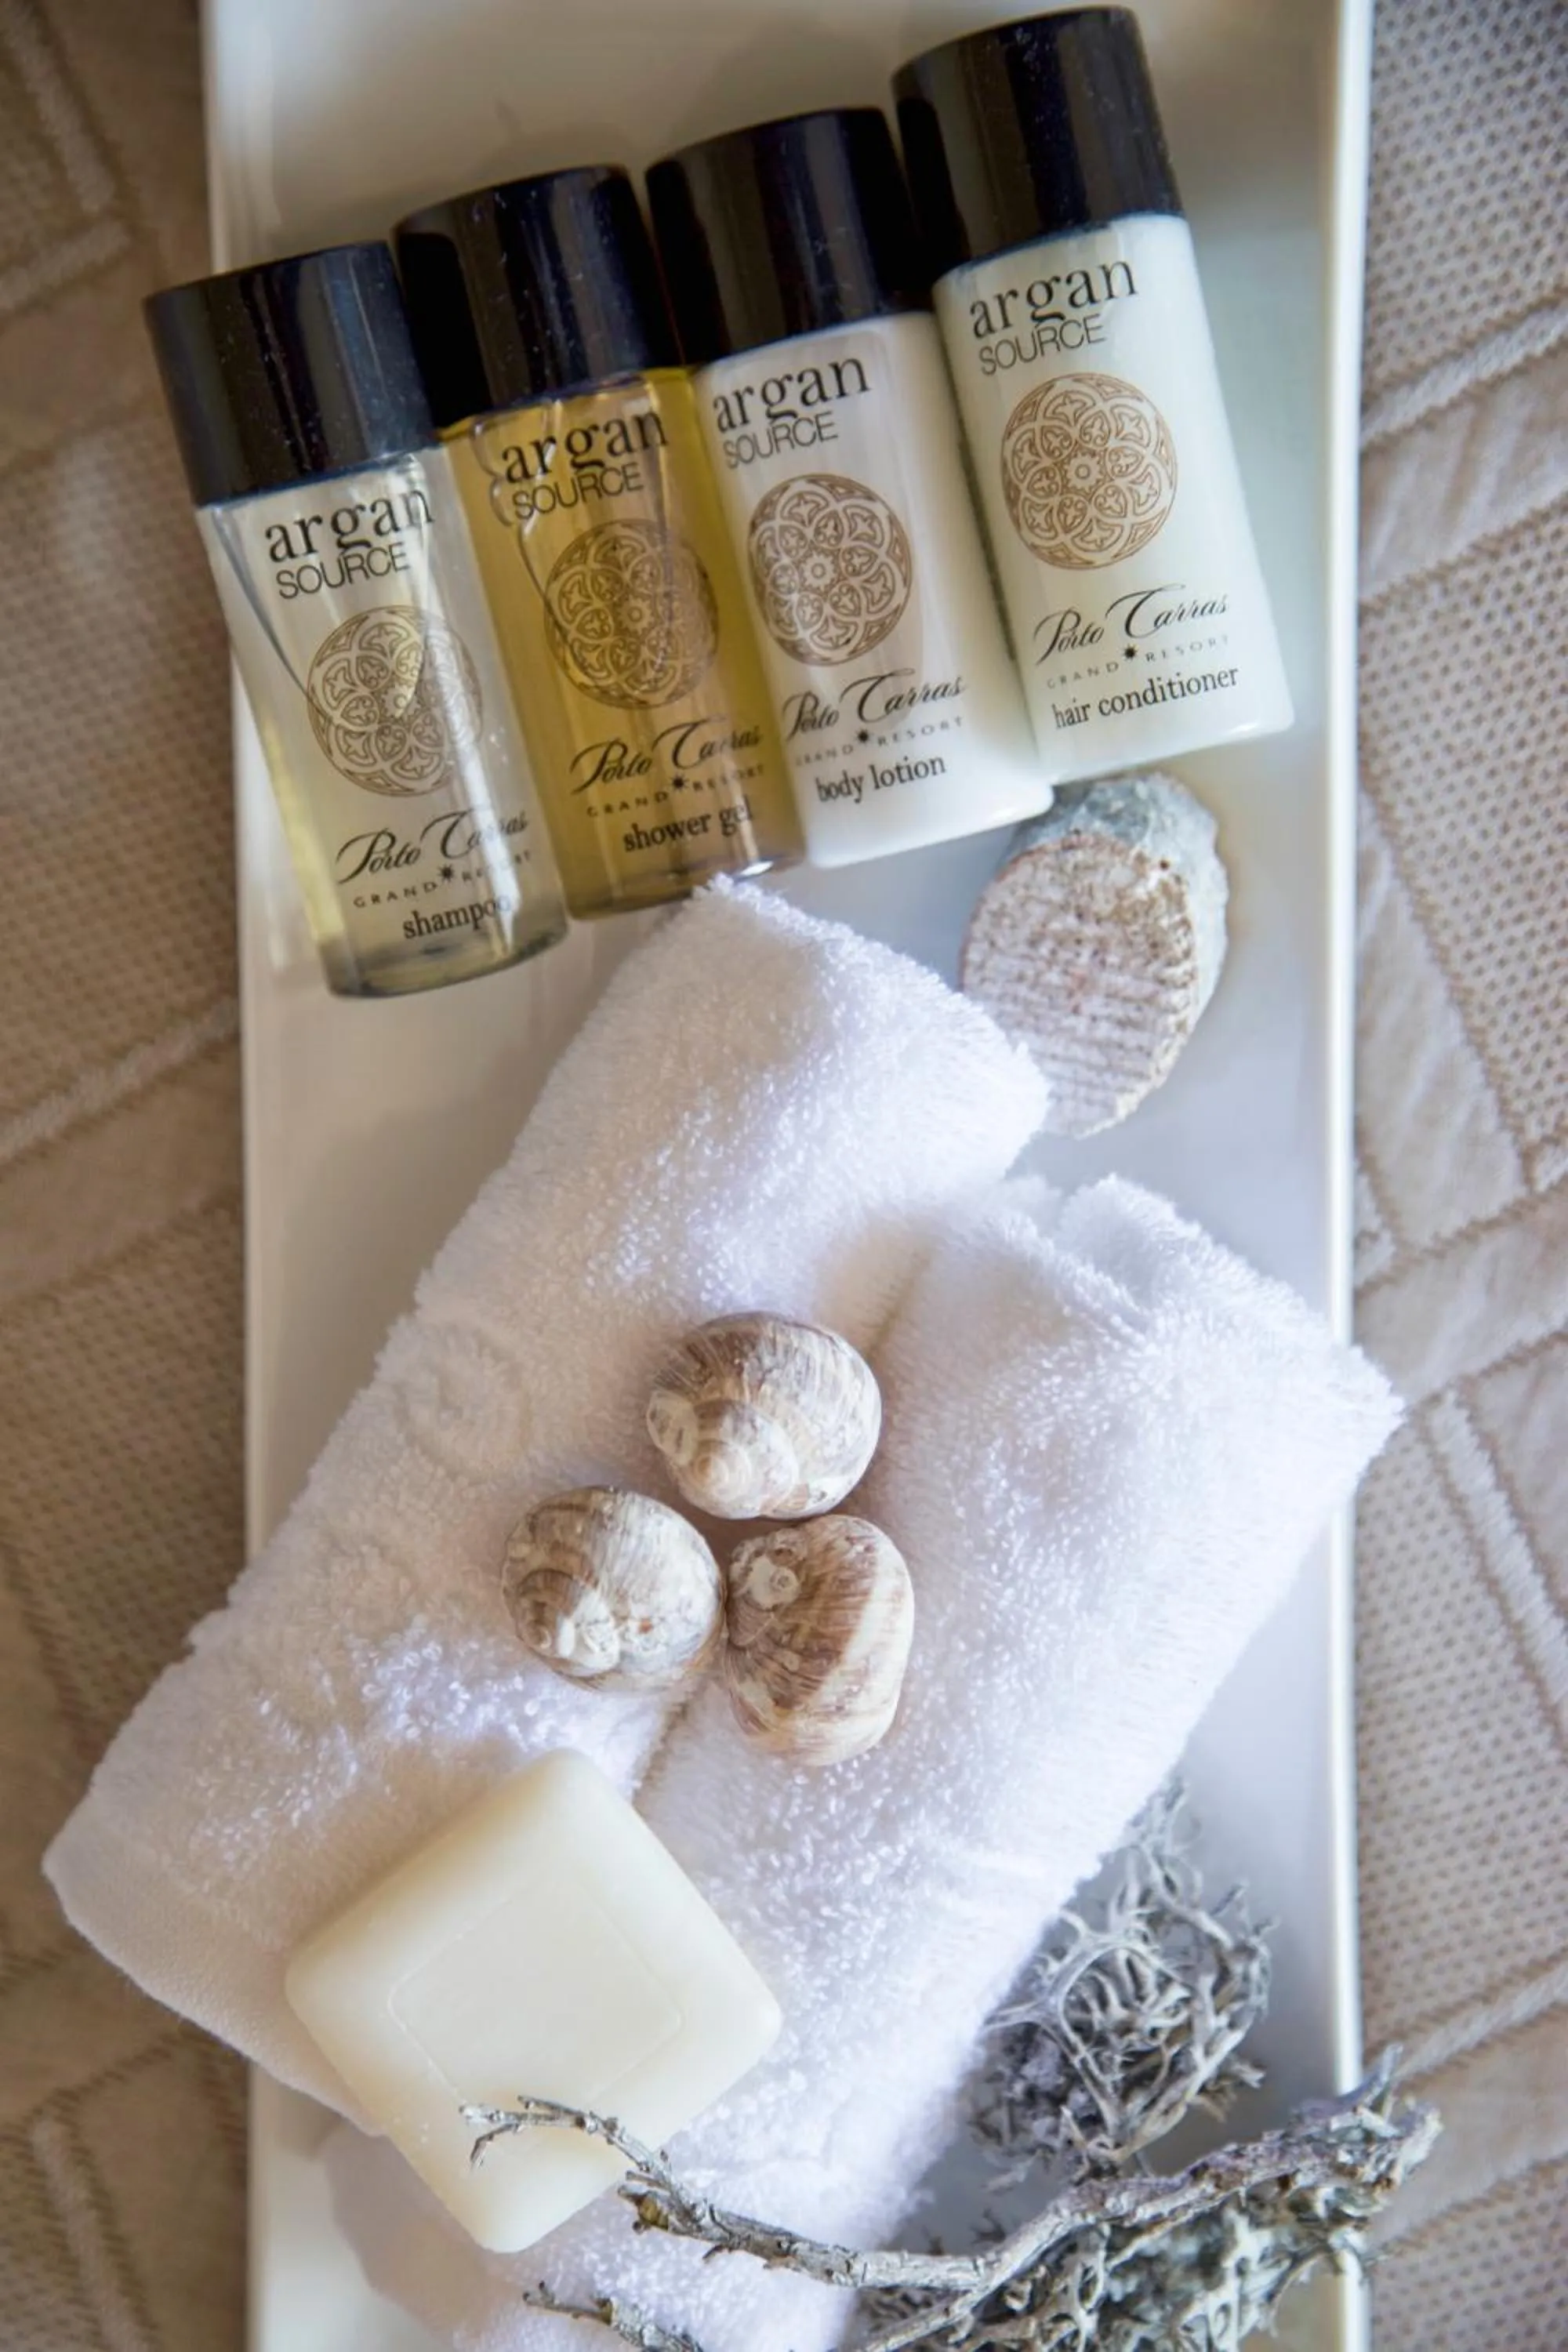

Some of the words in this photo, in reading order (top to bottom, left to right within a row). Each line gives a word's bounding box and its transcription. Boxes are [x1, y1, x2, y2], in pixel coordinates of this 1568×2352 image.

[970, 260, 1138, 339] argan
[980, 314, 1106, 376] SOURCE
[713, 358, 871, 432] argan
[502, 411, 669, 484] argan
[723, 410, 838, 470] SOURCE
[513, 462, 644, 520] SOURCE
[265, 489, 435, 563] argan
[276, 542, 411, 599] SOURCE
[1047, 661, 1119, 689] GRAND
[1145, 634, 1229, 662] RESORT
[1051, 698, 1091, 730] hair
[1098, 667, 1239, 717] conditioner
[796, 744, 854, 767] GRAND
[877, 715, 963, 747] RESORT
[586, 791, 669, 818] GRAND
[815, 770, 864, 804] body
[869, 756, 946, 790] lotion
[623, 812, 711, 852] shower
[719, 793, 753, 837] gel
[354, 880, 437, 908] GRAND
